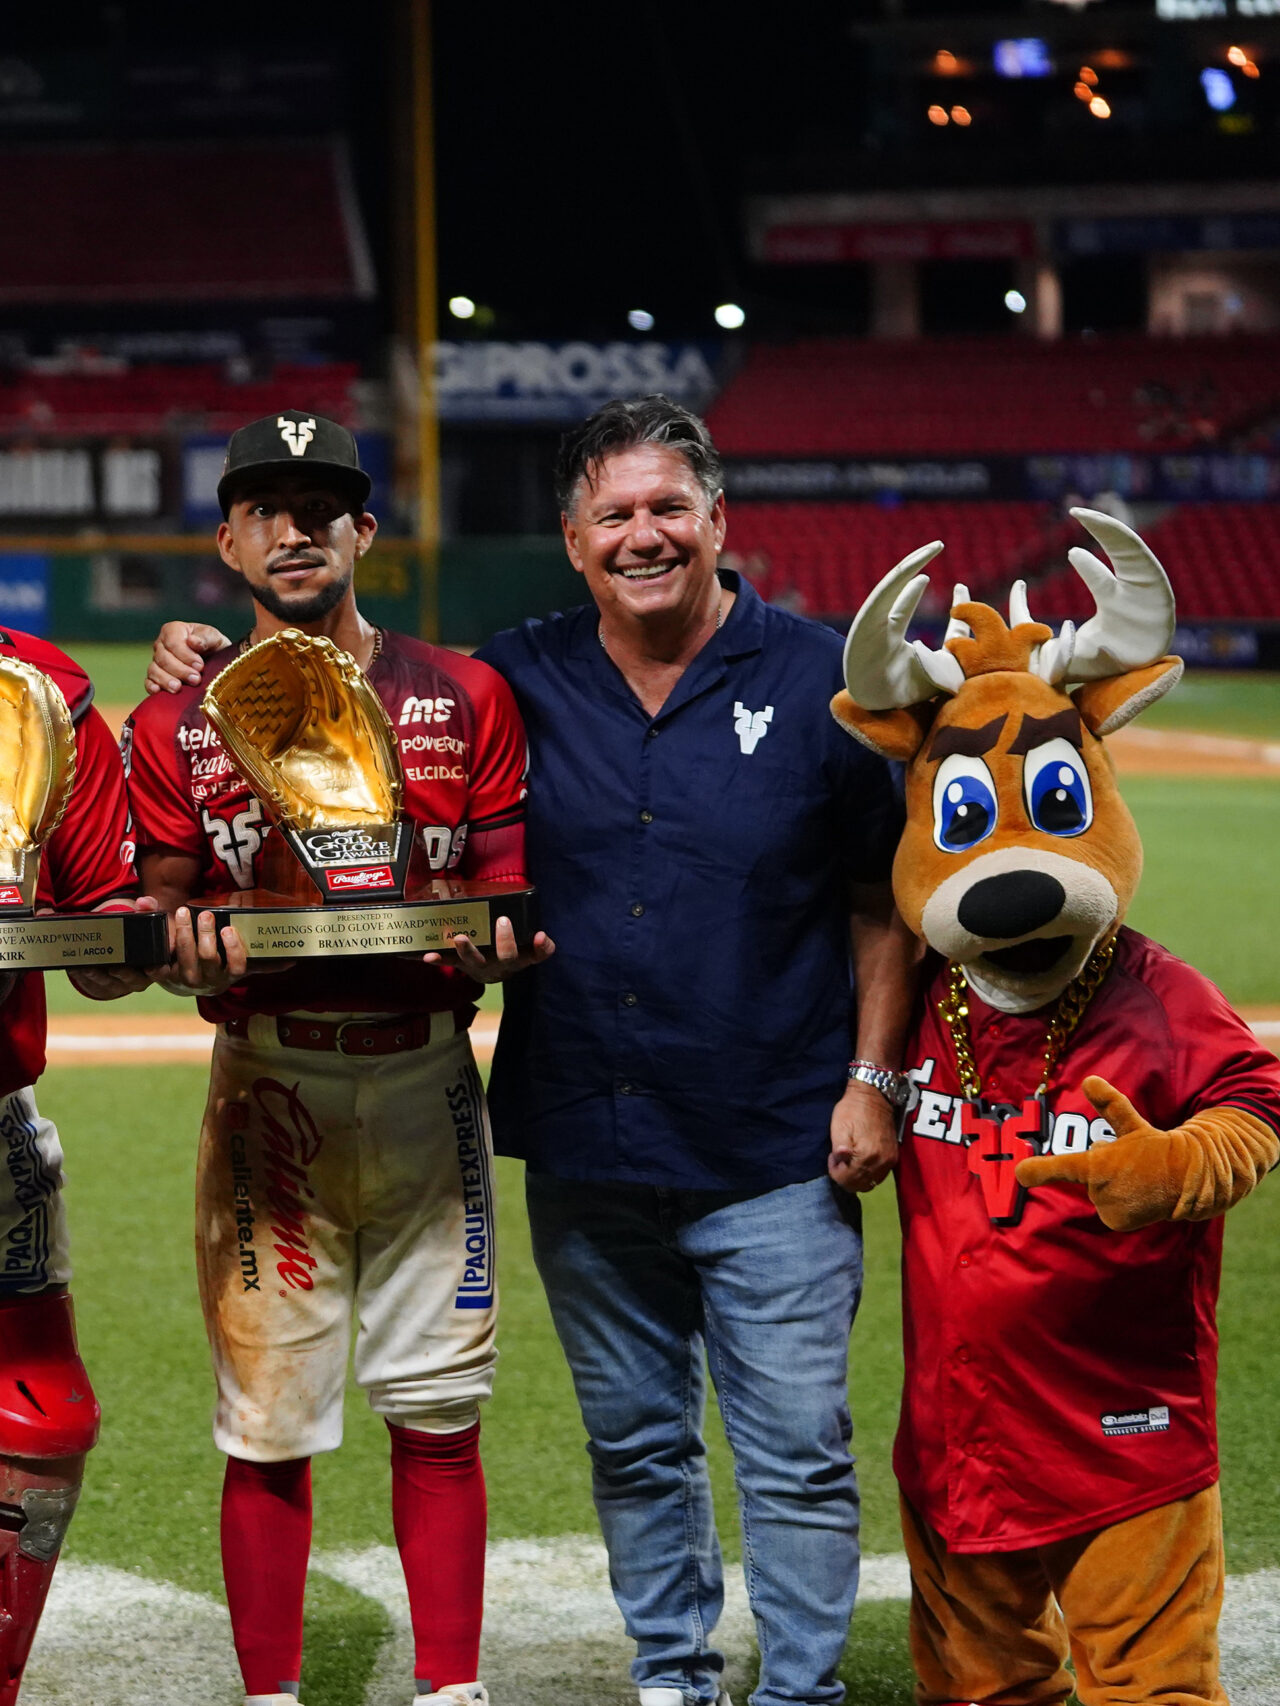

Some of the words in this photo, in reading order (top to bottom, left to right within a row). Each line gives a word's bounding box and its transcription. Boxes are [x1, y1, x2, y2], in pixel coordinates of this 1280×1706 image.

[333, 871, 386, 884] Rawlings
[337, 913, 381, 921] PRESENTED
[384, 912, 393, 920] TO
[17, 926, 26, 934] TO
[257, 924, 313, 936] RAWLINGS
[315, 924, 346, 934] GOLD
[348, 921, 385, 932] GLOVE
[430, 916, 469, 926] WINNER
[62, 932, 102, 943] WINNER
[319, 937, 359, 949] BRAYAN
[360, 935, 413, 947] QUINTERO
[272, 940, 296, 949] ARCO
[0, 950, 26, 962] KIRK
[83, 946, 107, 956] ARCO
[252, 1076, 324, 1292] Caliente
[445, 1084, 486, 1283] PAQUETEXPRESS
[230, 1133, 261, 1293] caliente.mx
